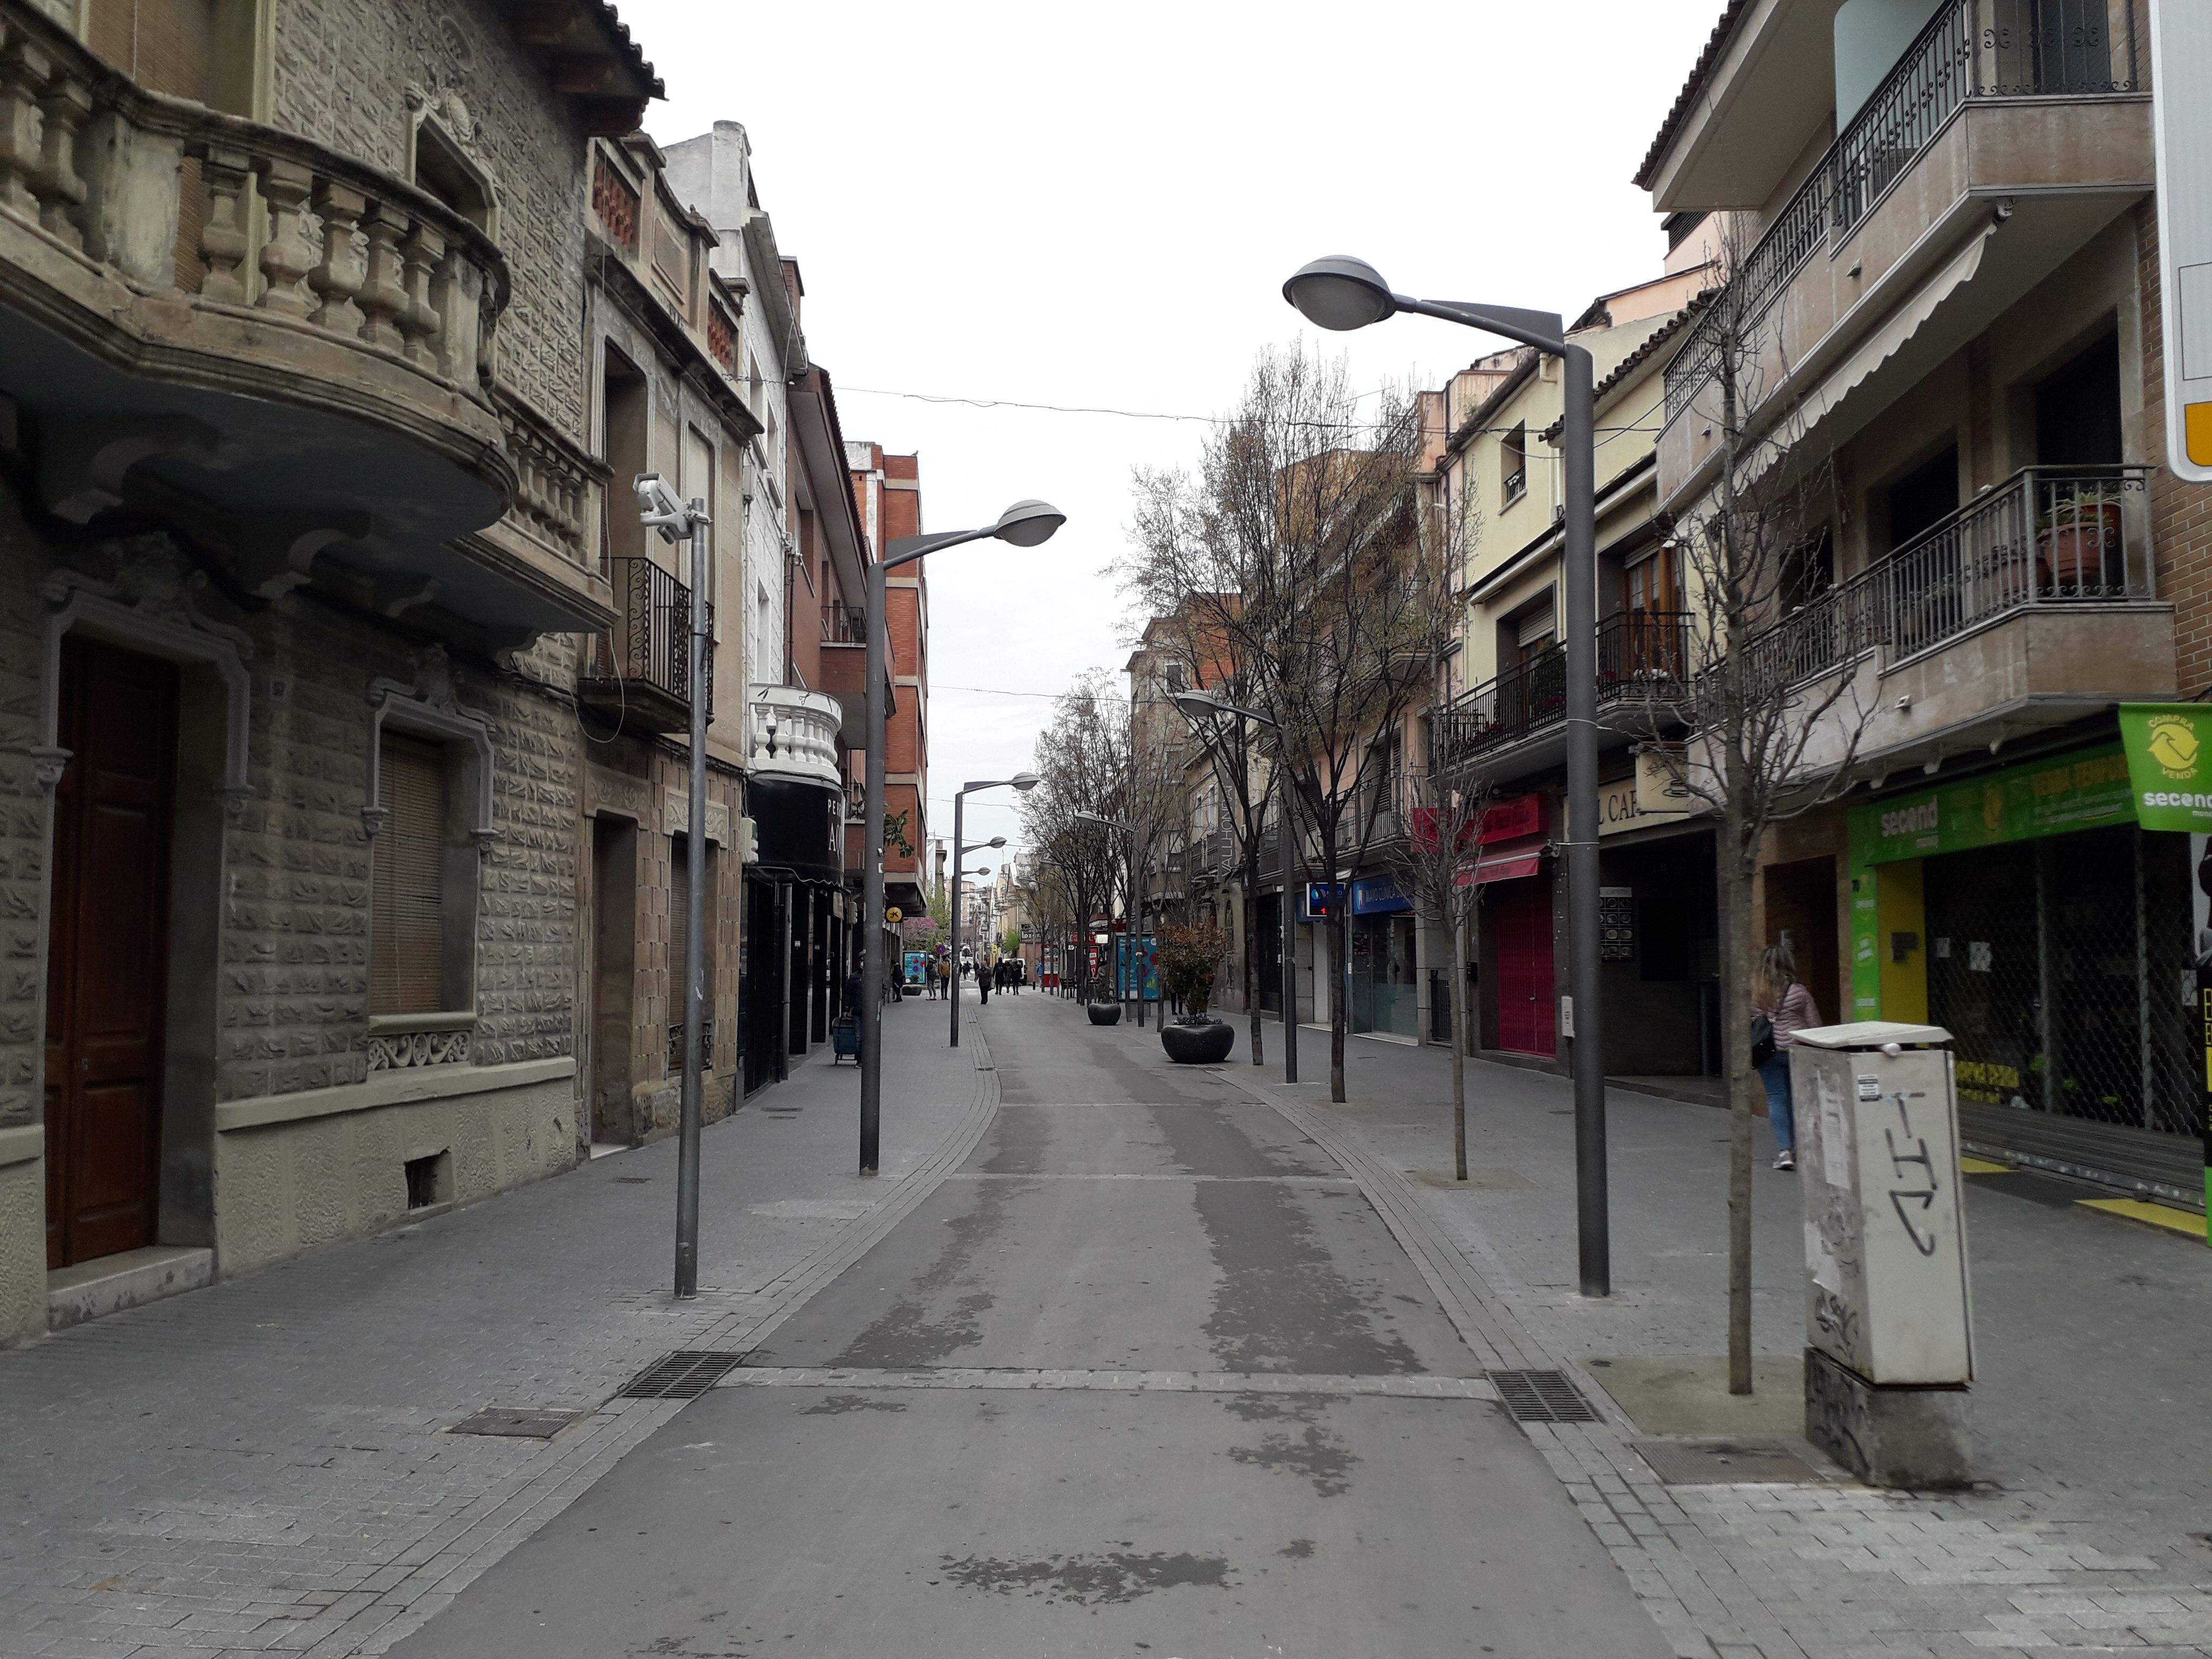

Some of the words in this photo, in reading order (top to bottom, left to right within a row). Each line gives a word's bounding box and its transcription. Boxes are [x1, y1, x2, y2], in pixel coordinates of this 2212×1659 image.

[2148, 714, 2194, 730] COMPRA
[2162, 766, 2199, 779] VENDA
[1881, 795, 1938, 838] second
